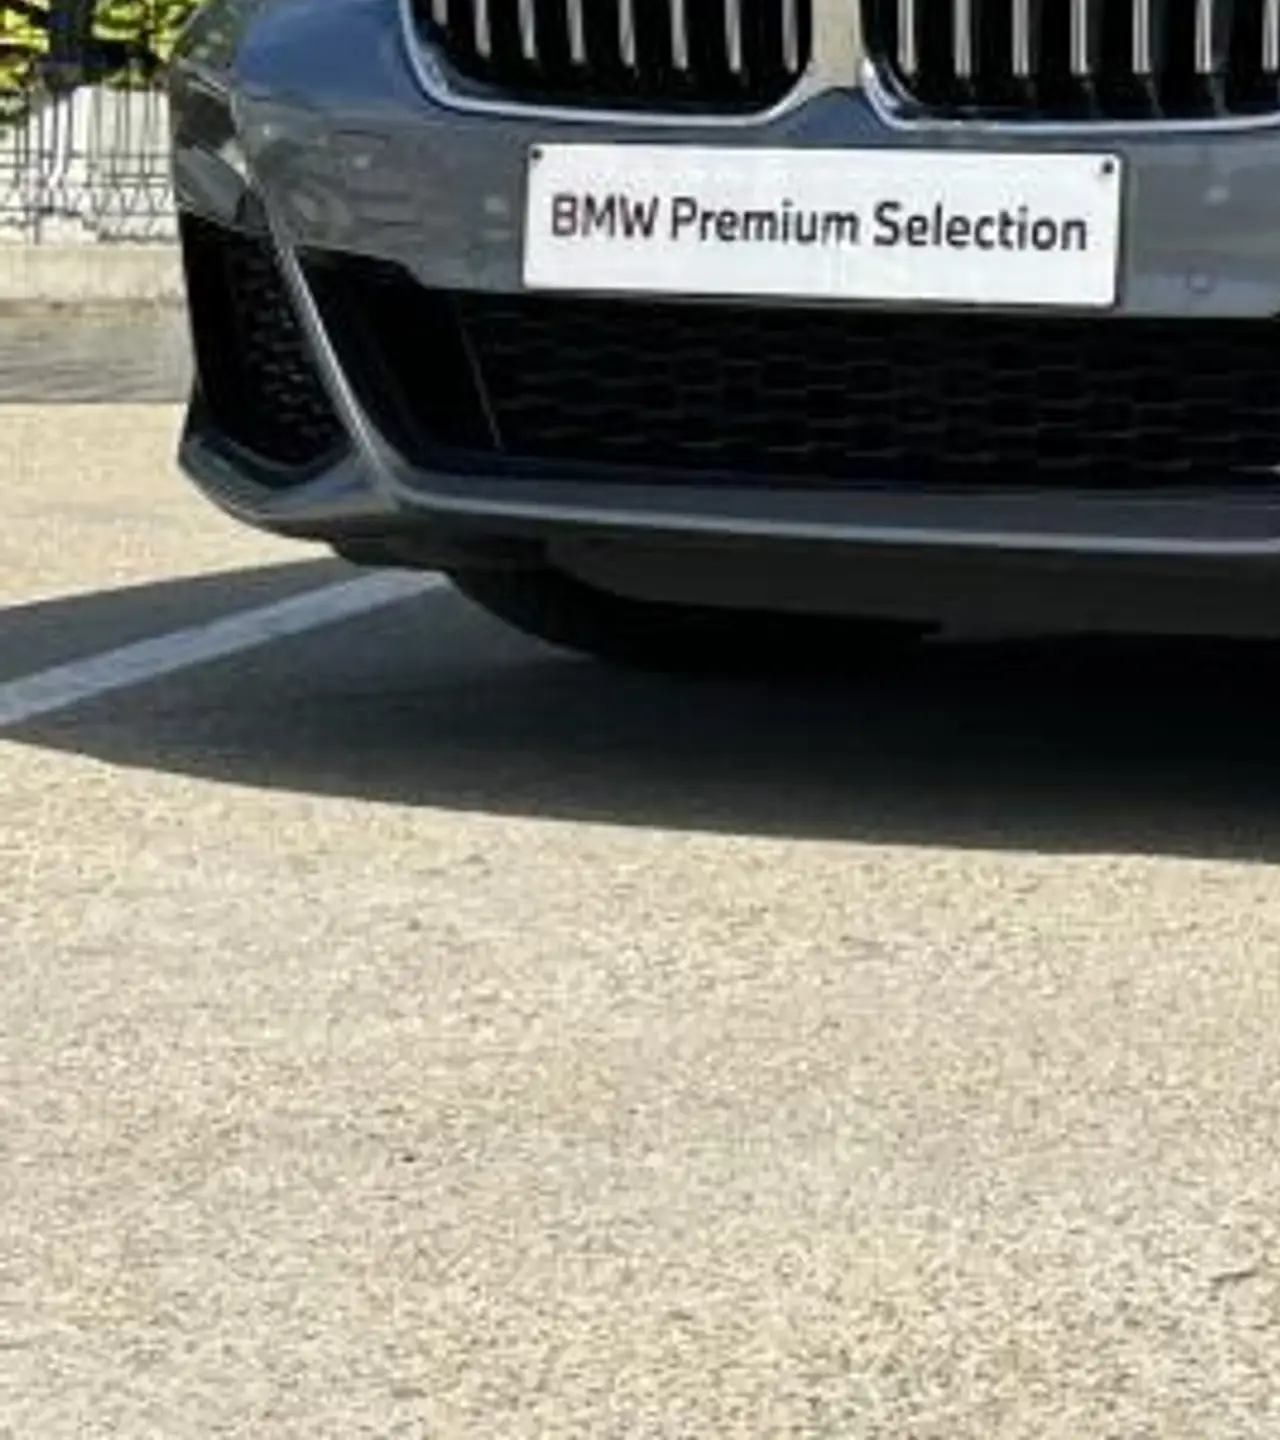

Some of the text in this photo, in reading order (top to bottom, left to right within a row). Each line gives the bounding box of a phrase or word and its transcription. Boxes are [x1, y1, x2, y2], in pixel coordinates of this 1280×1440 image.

[551, 192, 1088, 252] BMW Premium Selection
